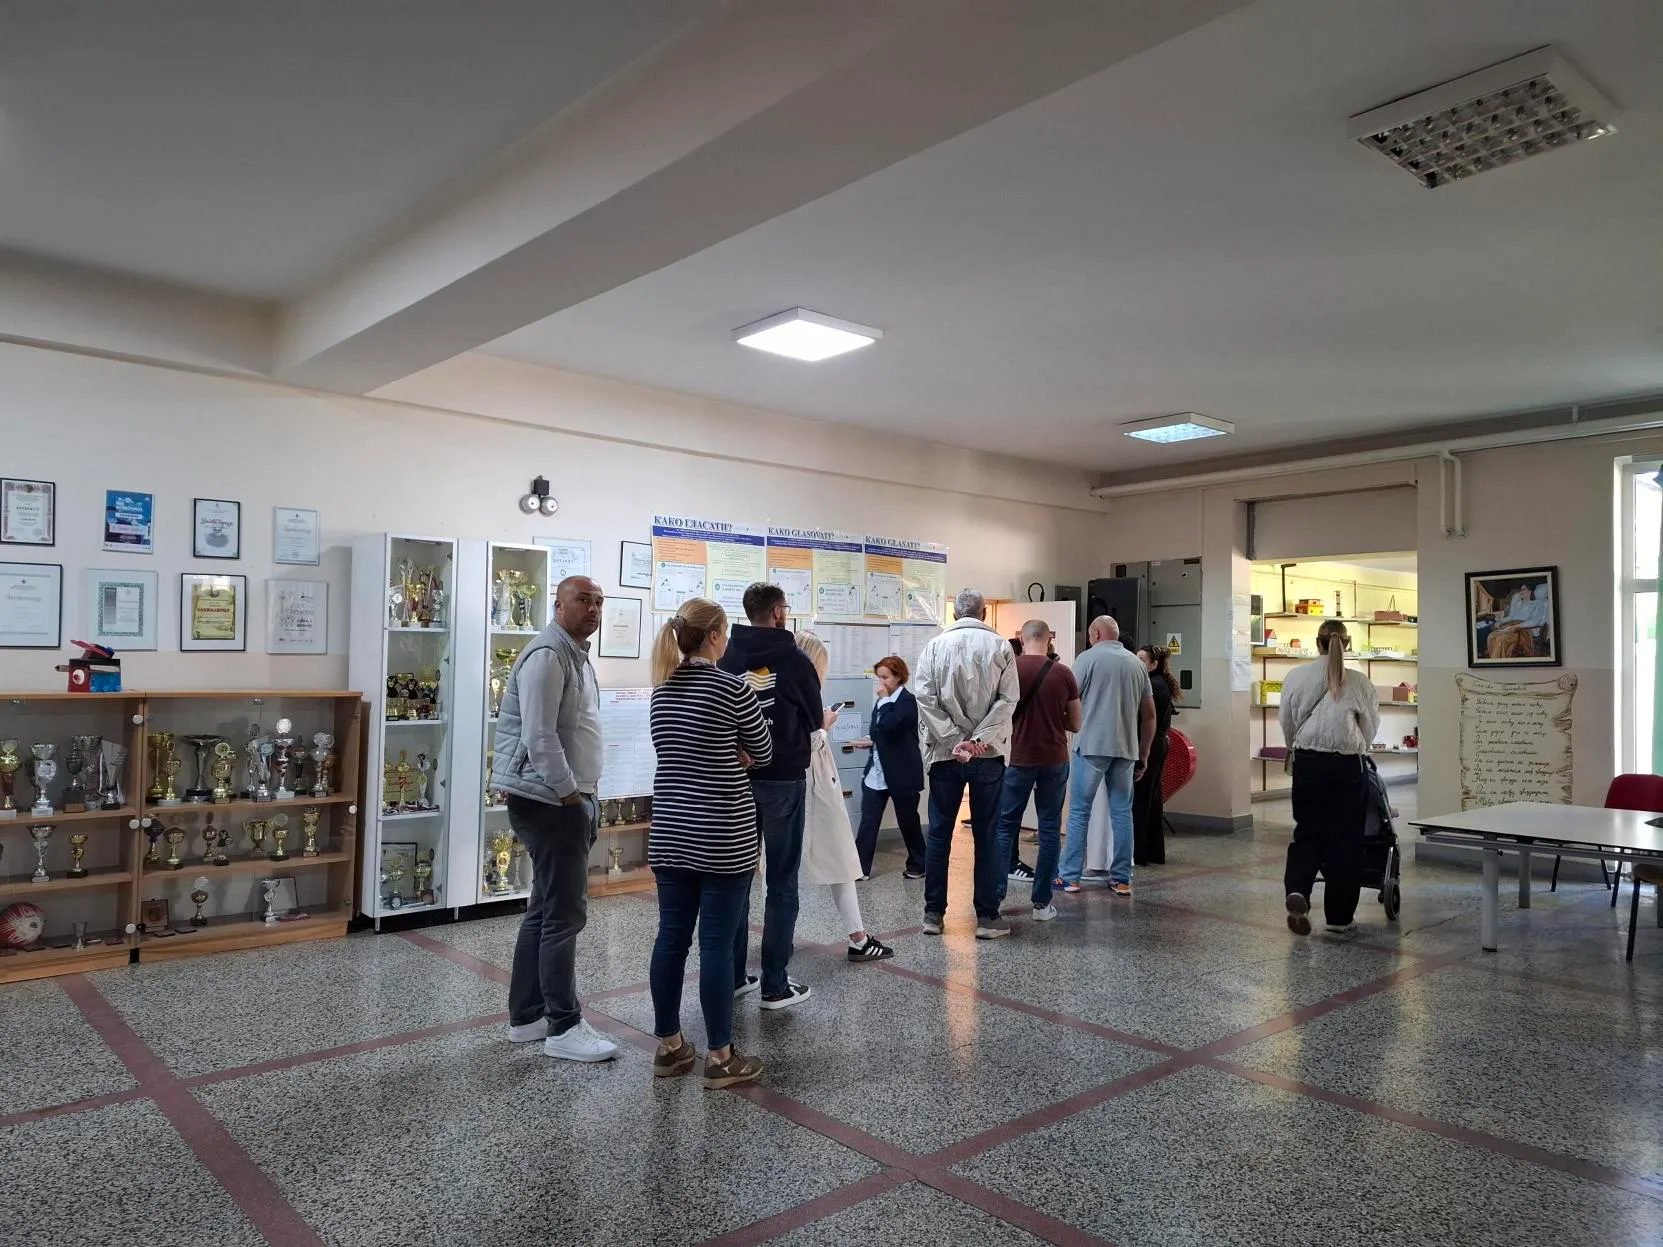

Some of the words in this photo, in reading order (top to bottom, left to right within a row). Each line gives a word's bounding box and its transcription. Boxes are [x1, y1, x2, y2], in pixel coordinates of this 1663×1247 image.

[654, 515, 684, 527] КАКО
[767, 527, 791, 537] KAKO
[791, 529, 835, 541] GLASOVATI?
[865, 535, 887, 545] KAKO
[887, 538, 921, 551] GLASATI?
